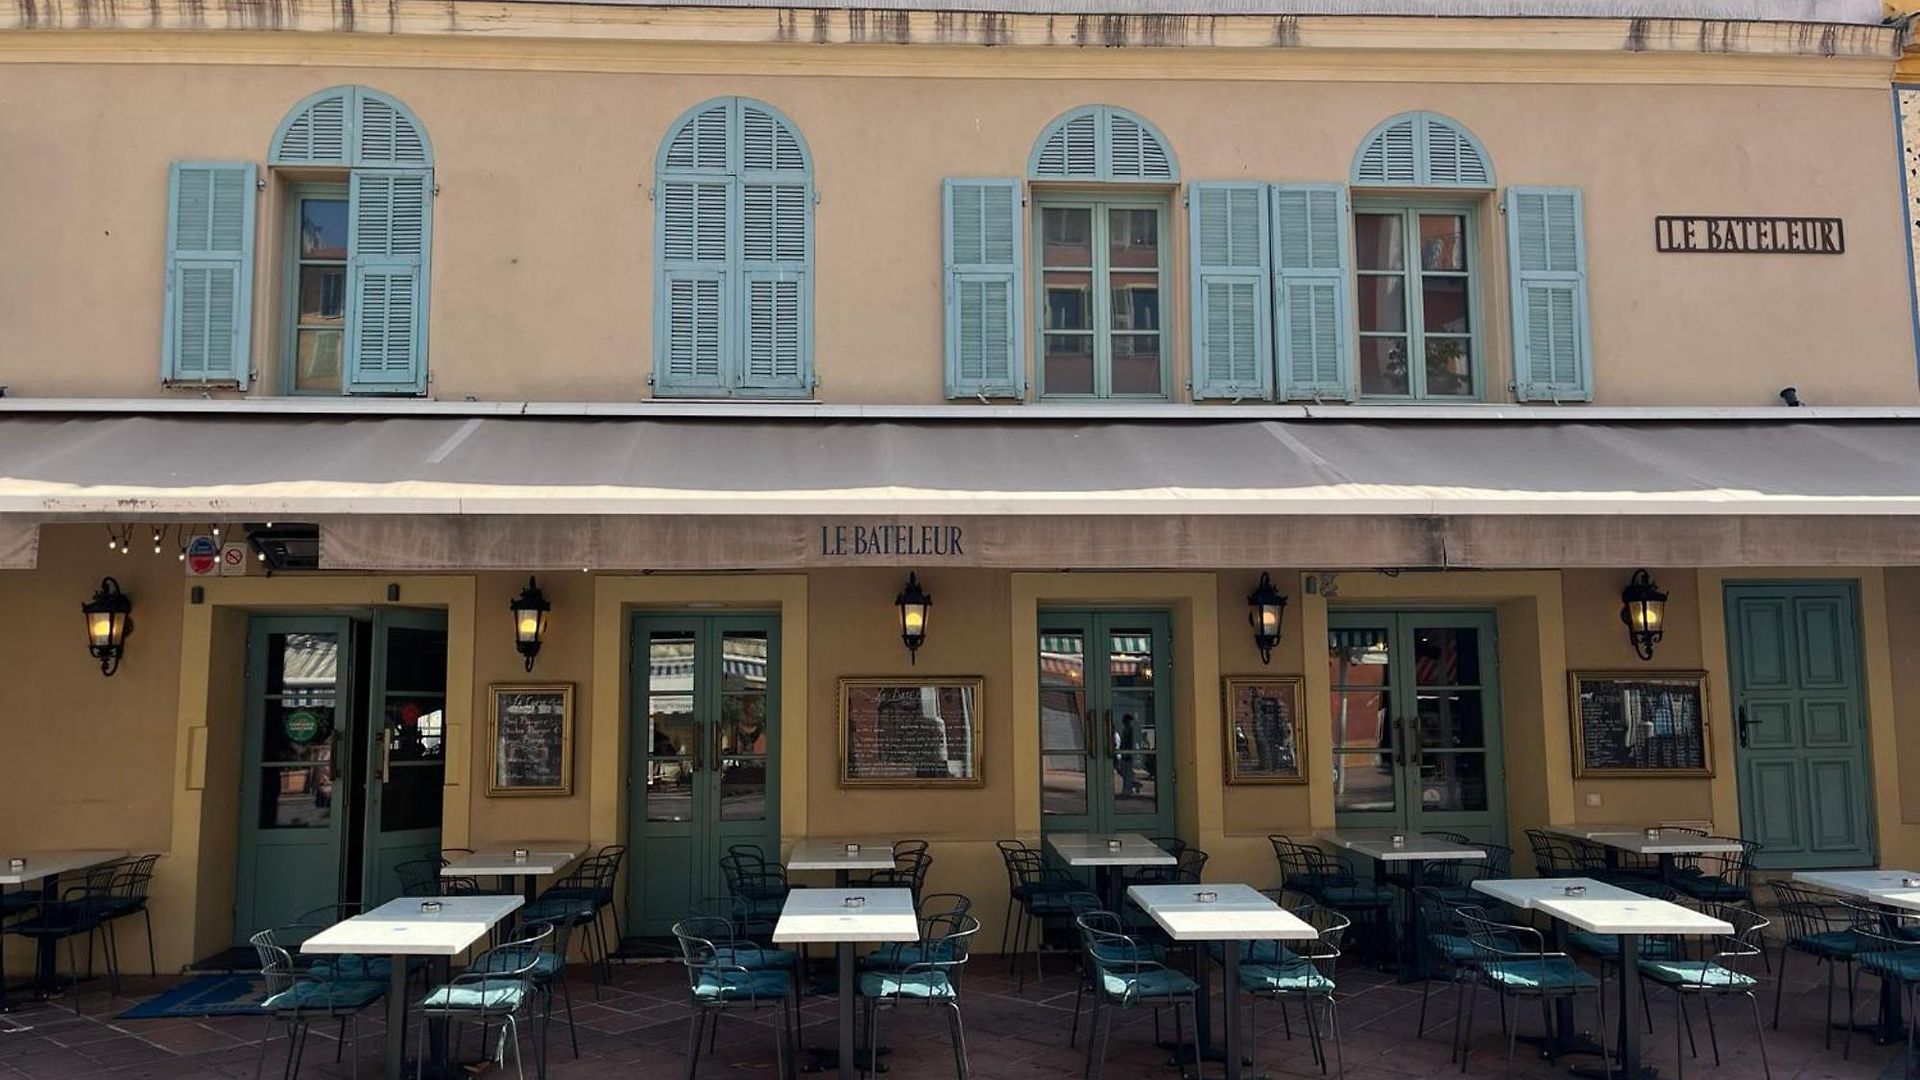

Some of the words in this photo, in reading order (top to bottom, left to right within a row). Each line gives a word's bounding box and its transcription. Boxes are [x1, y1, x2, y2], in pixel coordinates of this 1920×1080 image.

[1668, 219, 1697, 250] LE
[1707, 219, 1837, 252] BATELEUR
[821, 525, 848, 556] LE
[854, 525, 964, 556] BATELEUR
